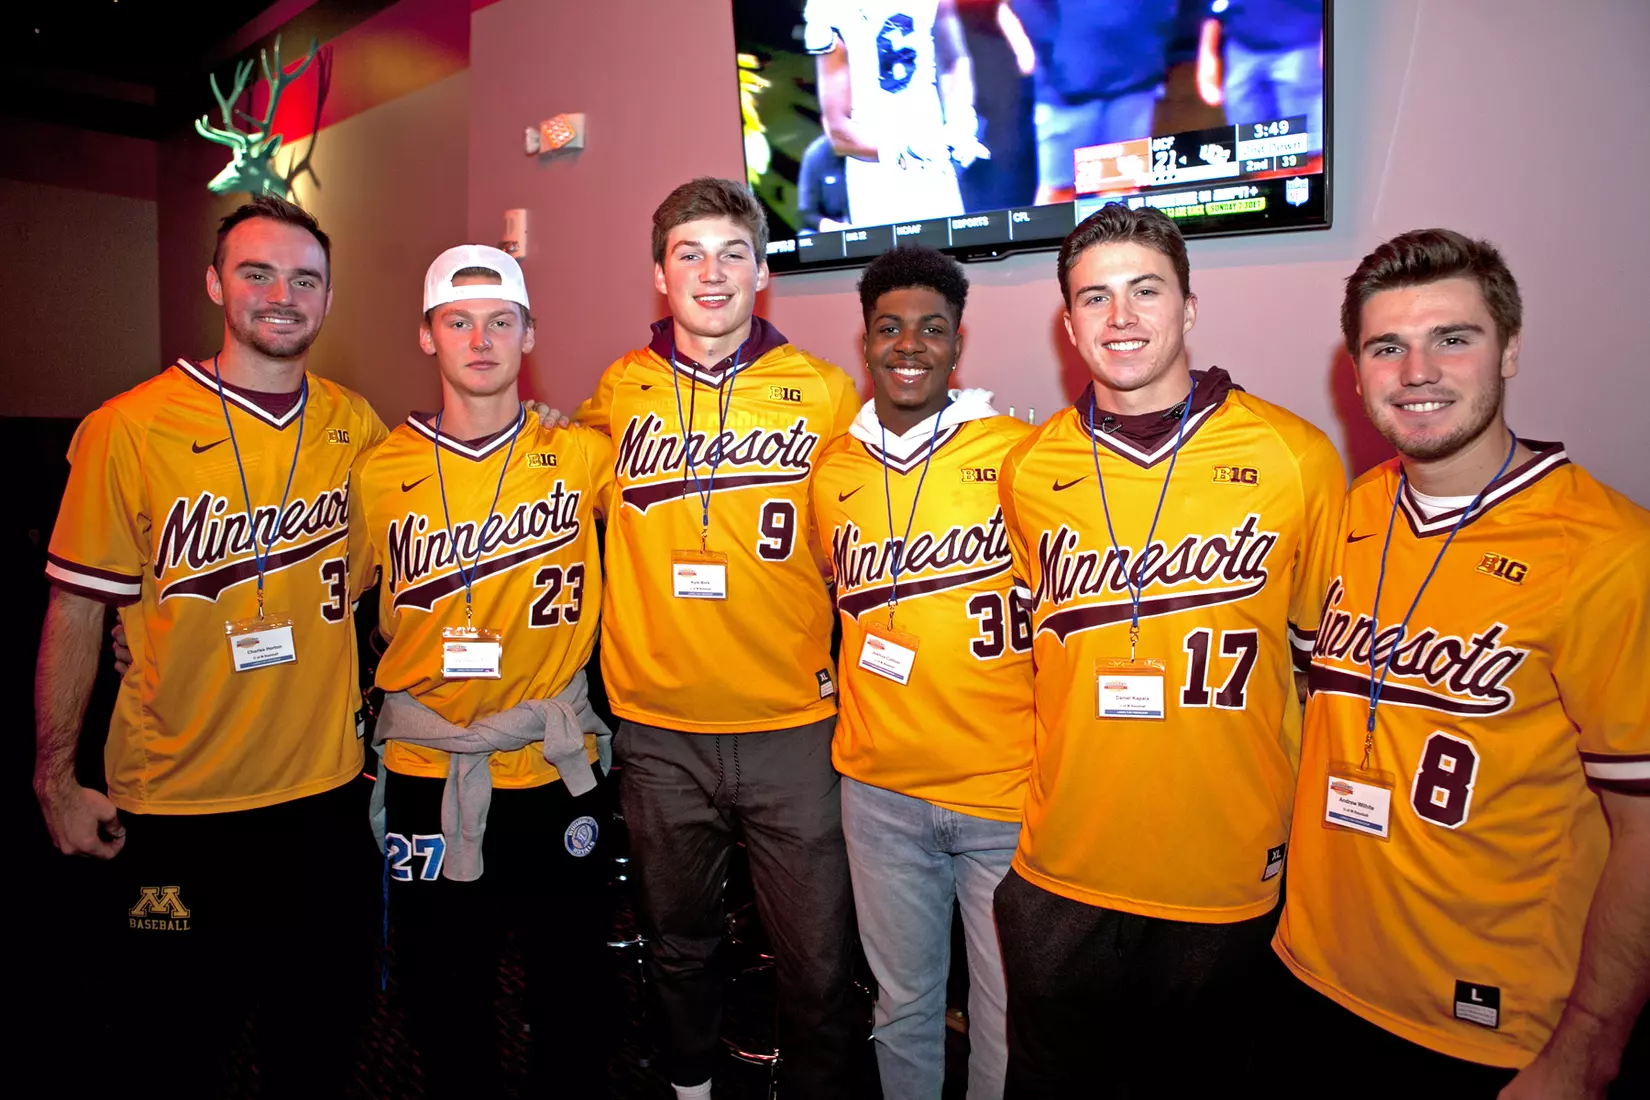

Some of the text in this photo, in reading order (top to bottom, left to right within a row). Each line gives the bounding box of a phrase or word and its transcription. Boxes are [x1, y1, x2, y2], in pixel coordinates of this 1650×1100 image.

[876, 12, 919, 95] 6
[1253, 119, 1290, 139] 3:49
[1153, 149, 1177, 173] 21
[1245, 158, 1269, 172] 2nd
[1281, 154, 1297, 168] 39
[896, 224, 922, 236] NCAAF
[951, 215, 990, 230] ESPORTS
[1012, 211, 1031, 223] CFL
[614, 411, 821, 482] Minnesota
[387, 479, 582, 596] Minnesota
[756, 498, 798, 563] 9
[1031, 512, 1281, 615] Minnesota
[528, 561, 586, 630] 23
[1180, 626, 1260, 711] 17
[1410, 730, 1481, 830] 8
[384, 831, 447, 882] 27
[1271, 848, 1282, 862] XL
[129, 885, 191, 919] M
[128, 917, 191, 931] BASEBALL
[1471, 986, 1484, 1002] L
